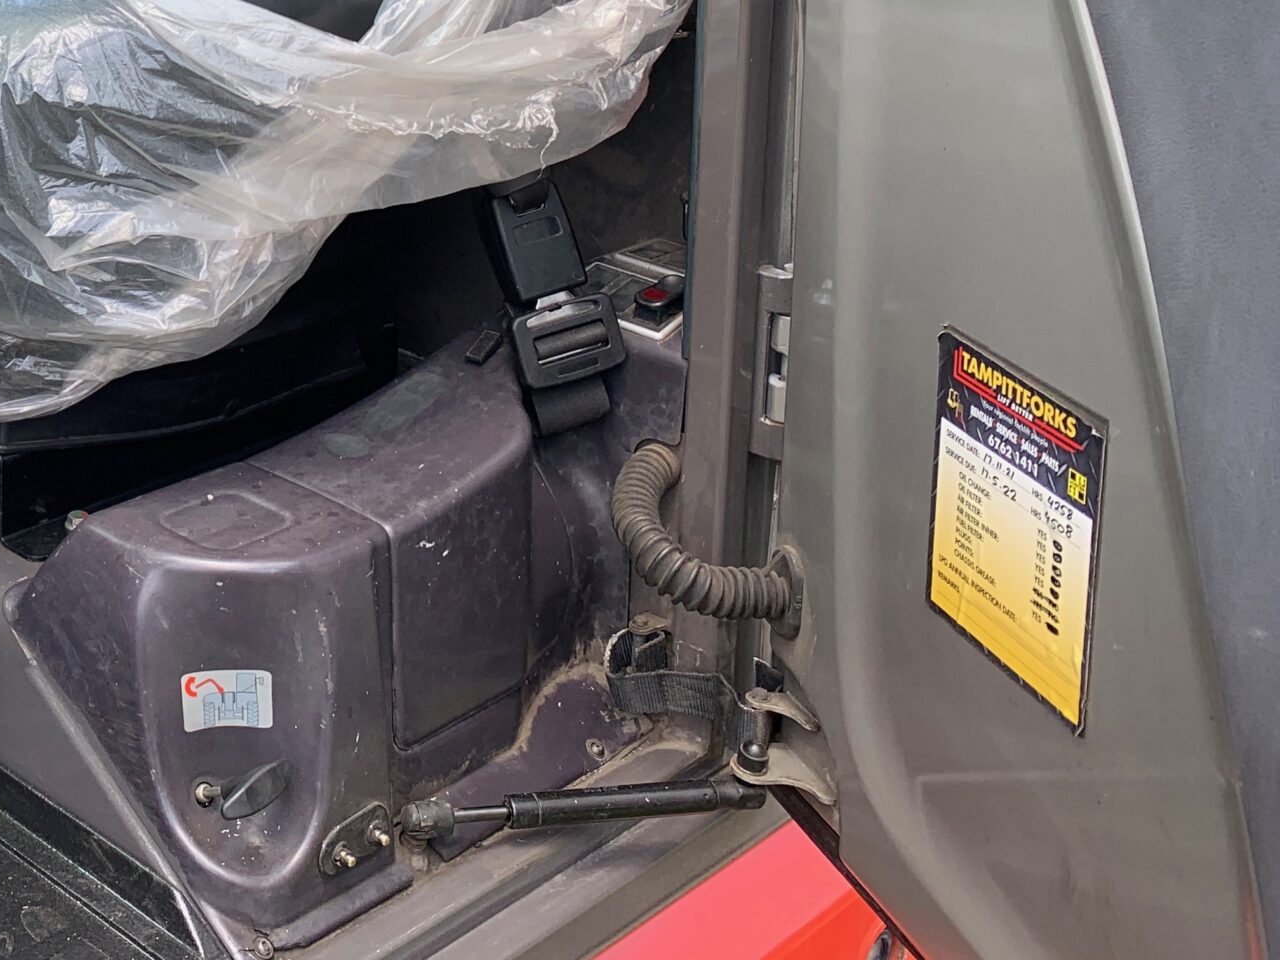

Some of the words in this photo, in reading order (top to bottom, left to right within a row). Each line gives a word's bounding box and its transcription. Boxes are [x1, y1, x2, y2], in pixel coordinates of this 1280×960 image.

[961, 350, 1077, 438] TAMPITTFORKS
[997, 394, 1010, 408] LIFT
[1010, 401, 1034, 422] BETTER
[970, 405, 993, 426] RENTALS
[996, 422, 1018, 444] SERVICE
[1021, 438, 1038, 458] SALES
[1041, 452, 1060, 473] PARTS
[987, 434, 1012, 459] 6762
[946, 429, 966, 449] SERVICE
[1032, 488, 1043, 502] HRS
[945, 446, 965, 466] SERVICE
[1030, 507, 1042, 521] HRS
[959, 471, 967, 483] OIL
[1037, 528, 1047, 541] YES
[1035, 552, 1046, 565] YES
[1036, 540, 1046, 553] YES
[1034, 575, 1044, 588] YES
[1035, 563, 1045, 576] YES
[971, 579, 1001, 611] INSPECTION
[1031, 610, 1042, 624] YES
